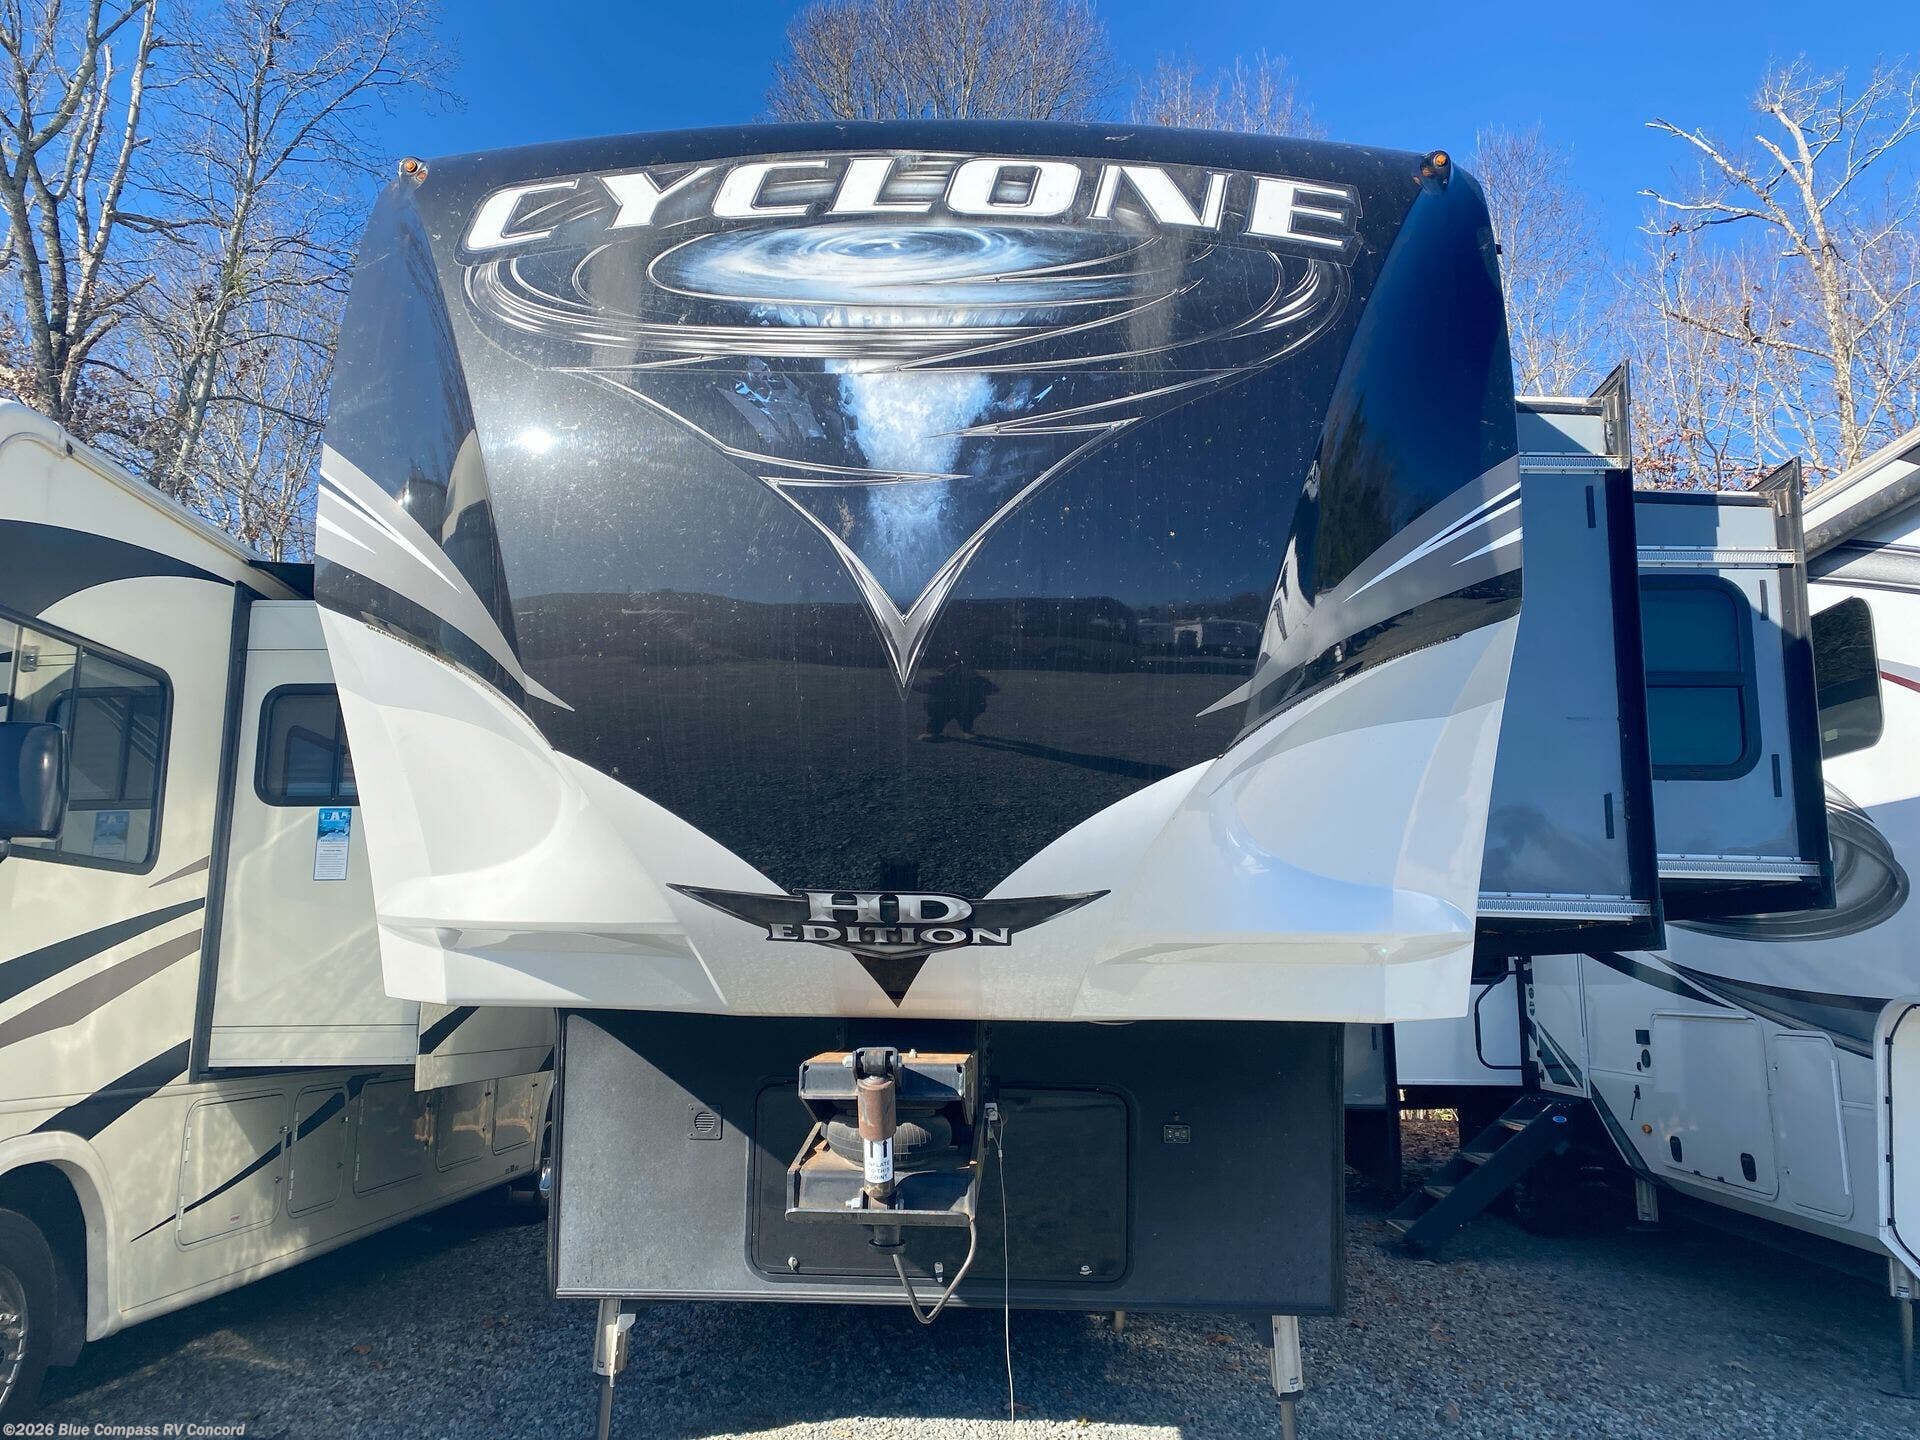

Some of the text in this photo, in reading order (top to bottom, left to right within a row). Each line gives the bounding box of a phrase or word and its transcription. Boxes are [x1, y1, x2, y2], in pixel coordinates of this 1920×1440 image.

[463, 156, 1352, 251] CYCLONE
[806, 891, 973, 924] HD
[769, 923, 1010, 945] EDITION
[868, 1159, 890, 1167] NFLATE
